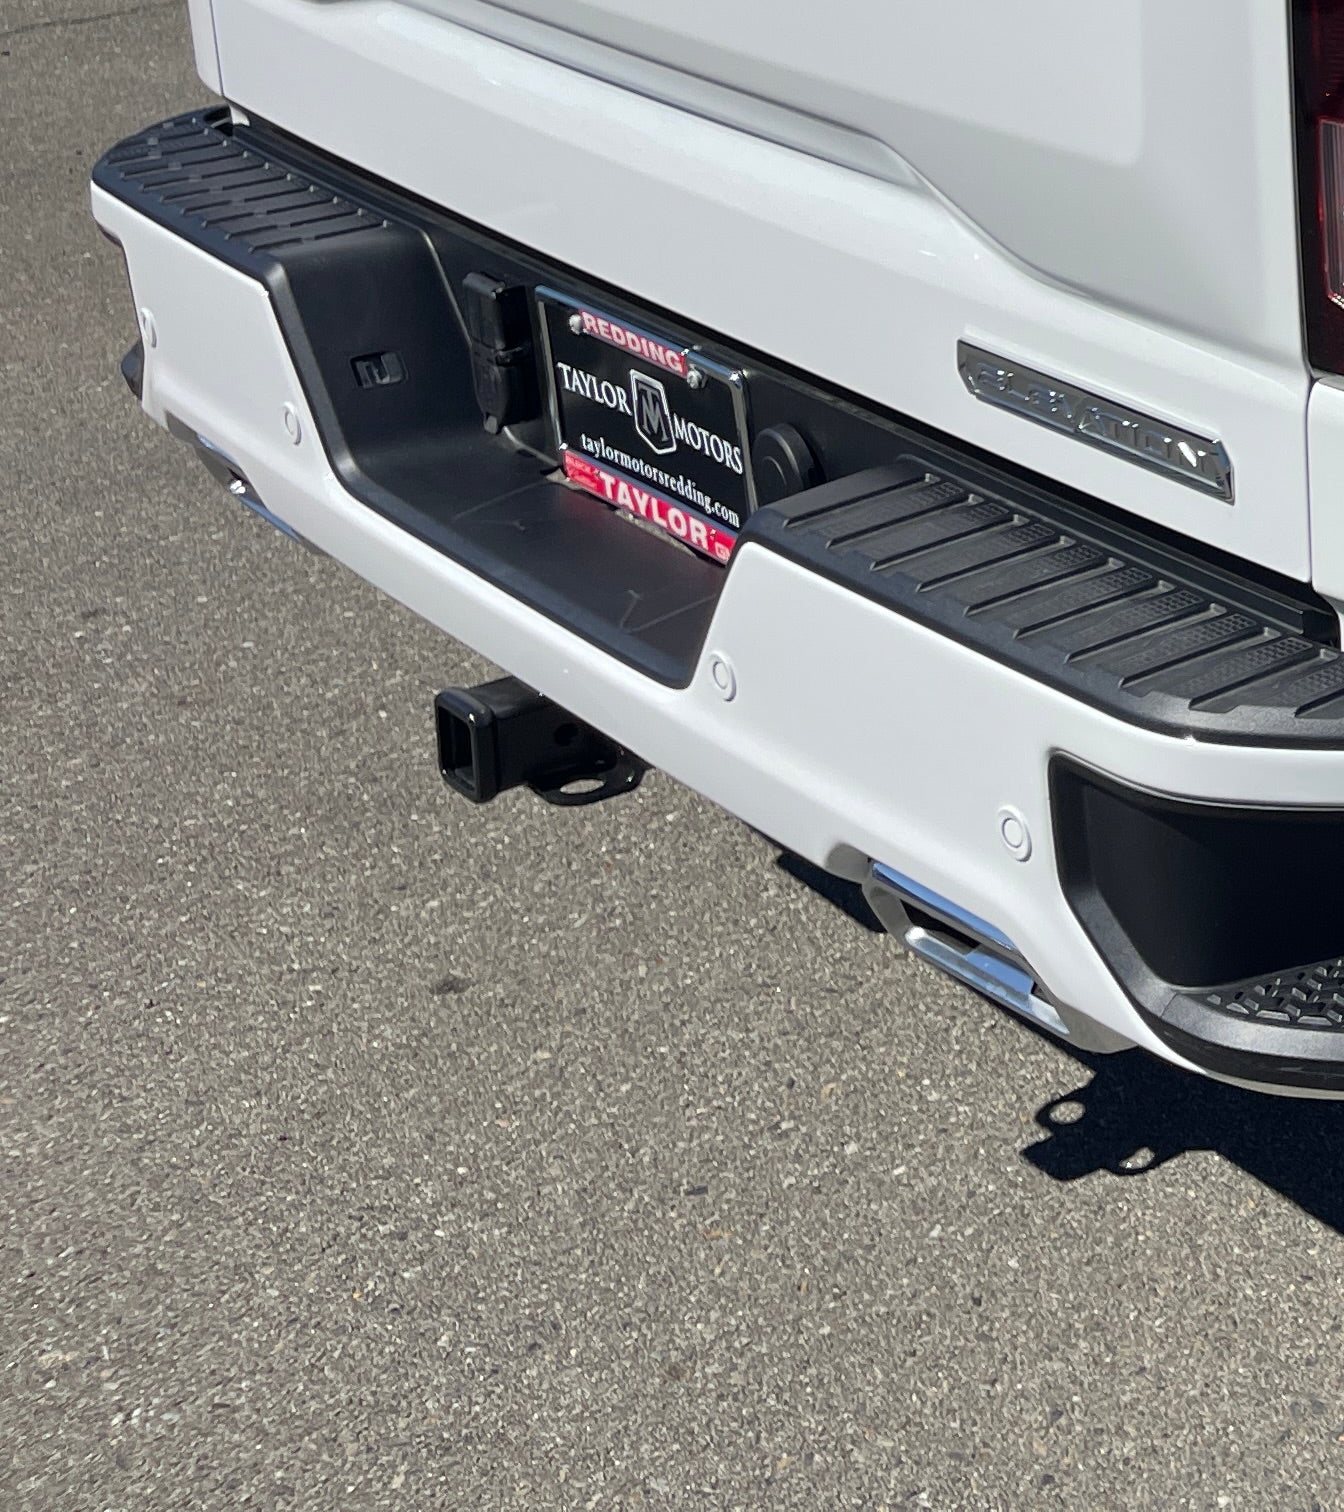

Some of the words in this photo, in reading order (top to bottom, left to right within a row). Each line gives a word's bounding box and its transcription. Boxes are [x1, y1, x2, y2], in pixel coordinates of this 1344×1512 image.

[581, 311, 685, 373] REDDING
[556, 361, 633, 417] TAYLOR
[672, 411, 744, 476] MOTORS
[975, 361, 1210, 474] ELEVATION
[580, 431, 741, 529] taylormotorsredding.com
[599, 471, 709, 551] TAYLOR
